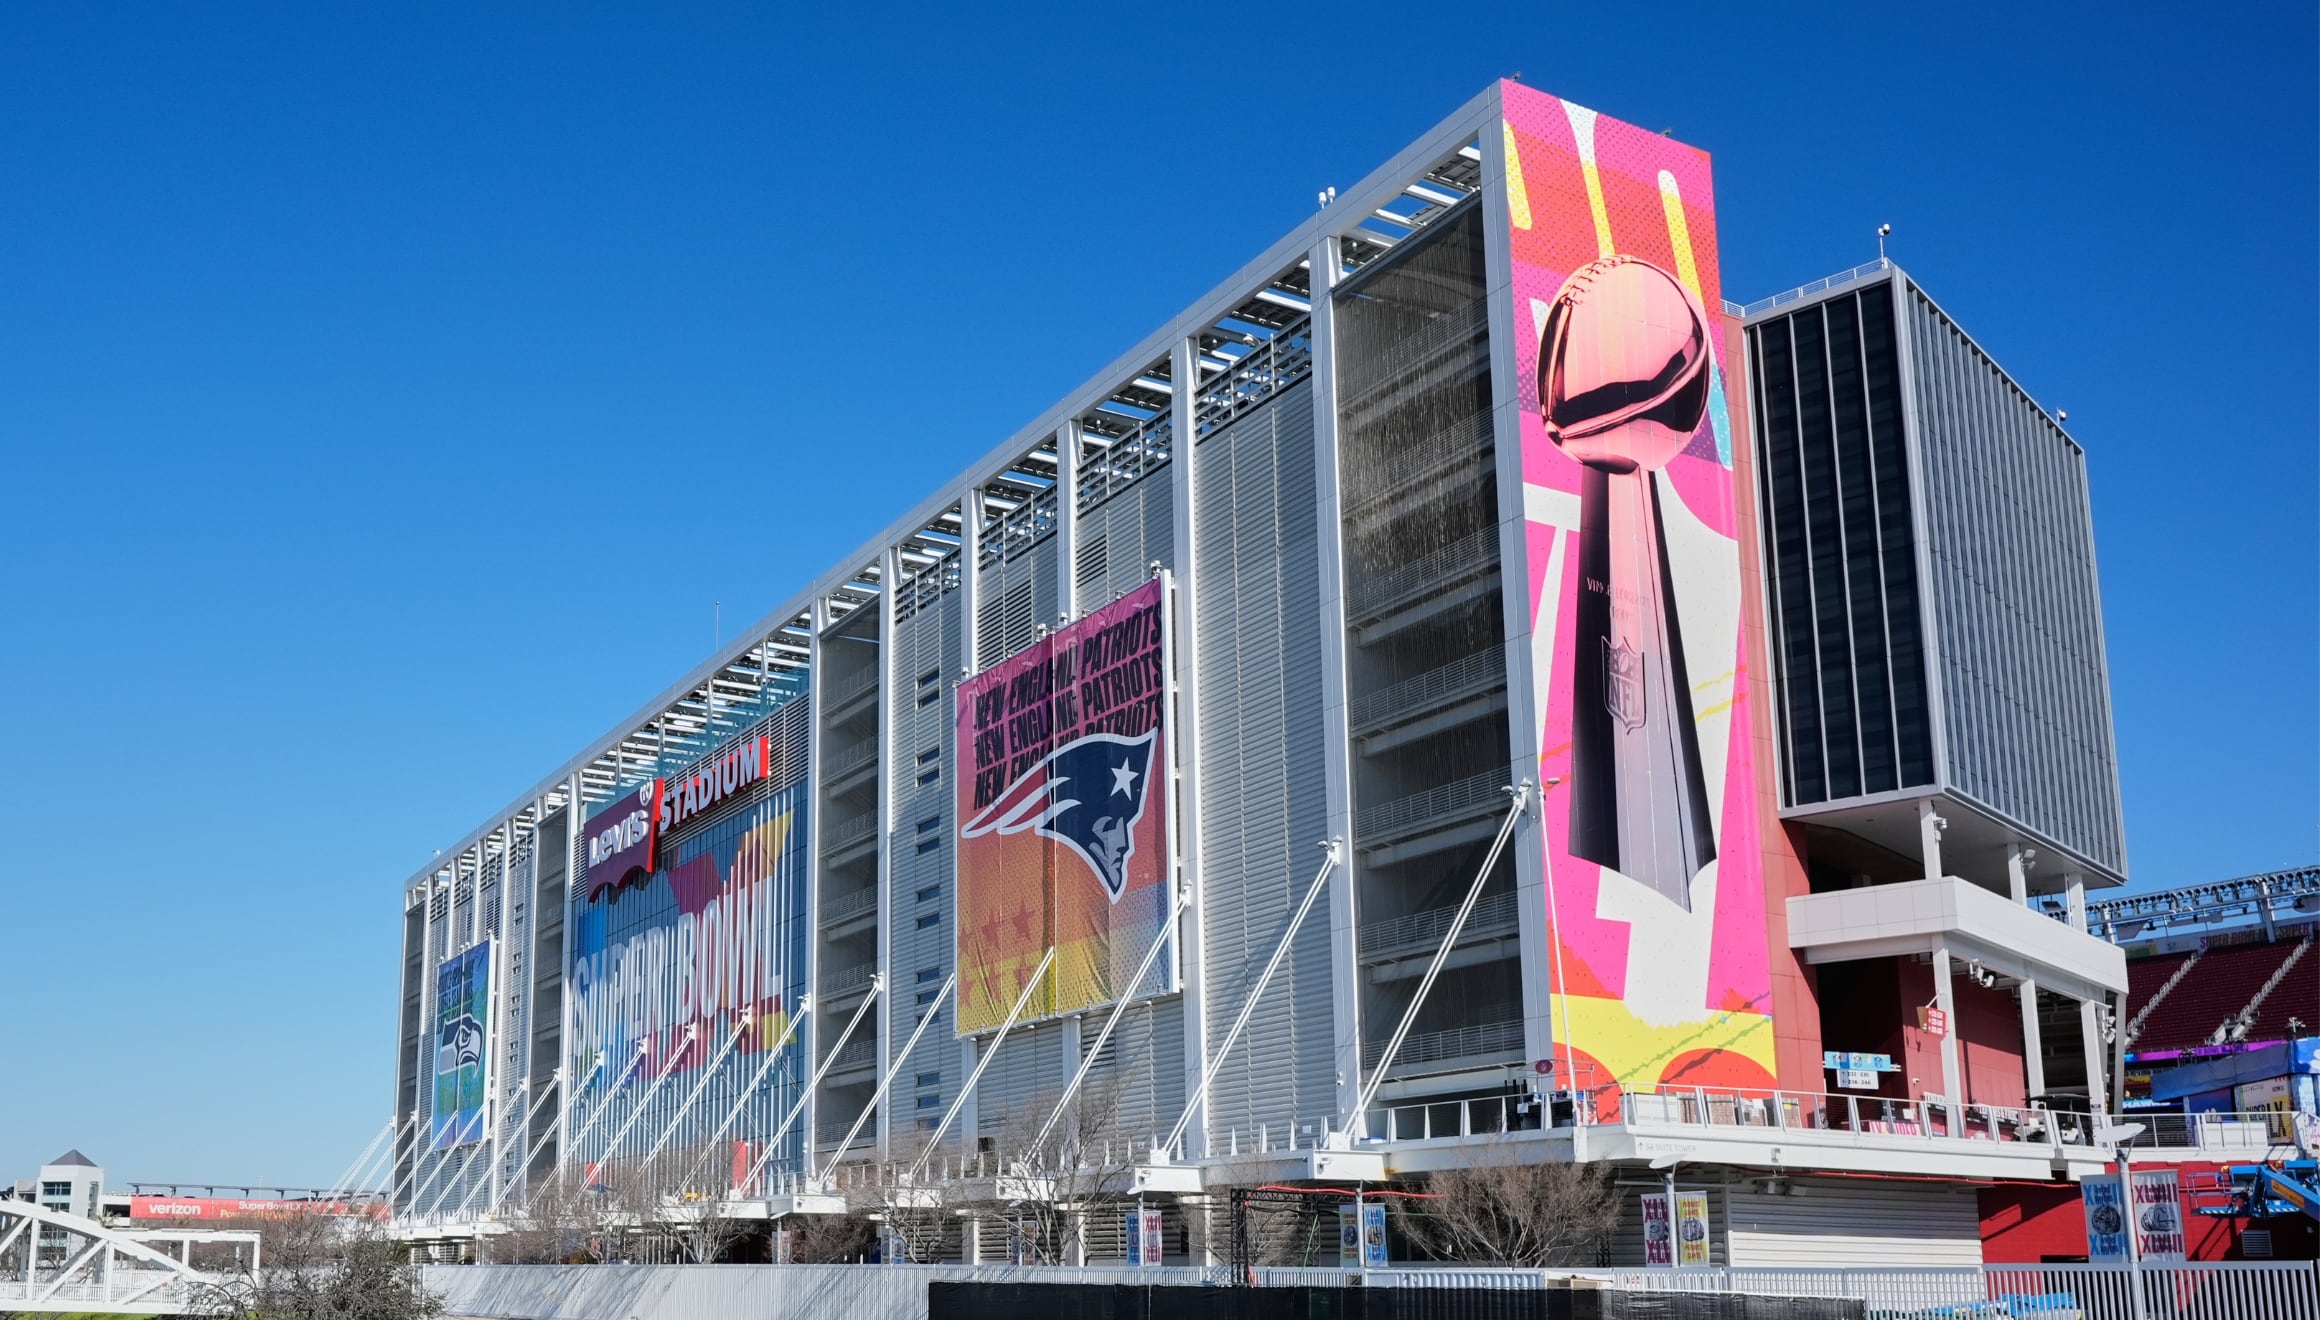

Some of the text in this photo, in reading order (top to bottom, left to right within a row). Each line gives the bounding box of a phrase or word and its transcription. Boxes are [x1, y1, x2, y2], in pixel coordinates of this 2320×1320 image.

[975, 682, 1007, 731] NEW
[1082, 602, 1161, 679] PATRIOTS
[975, 647, 1162, 770] NEW ENGLAND PATRIOTS
[659, 736, 765, 832] STADIUM
[974, 762, 1007, 810] NEW
[573, 875, 782, 1057] SUPER BOWL
[148, 1203, 202, 1215] verizon
[238, 1200, 265, 1211] Super
